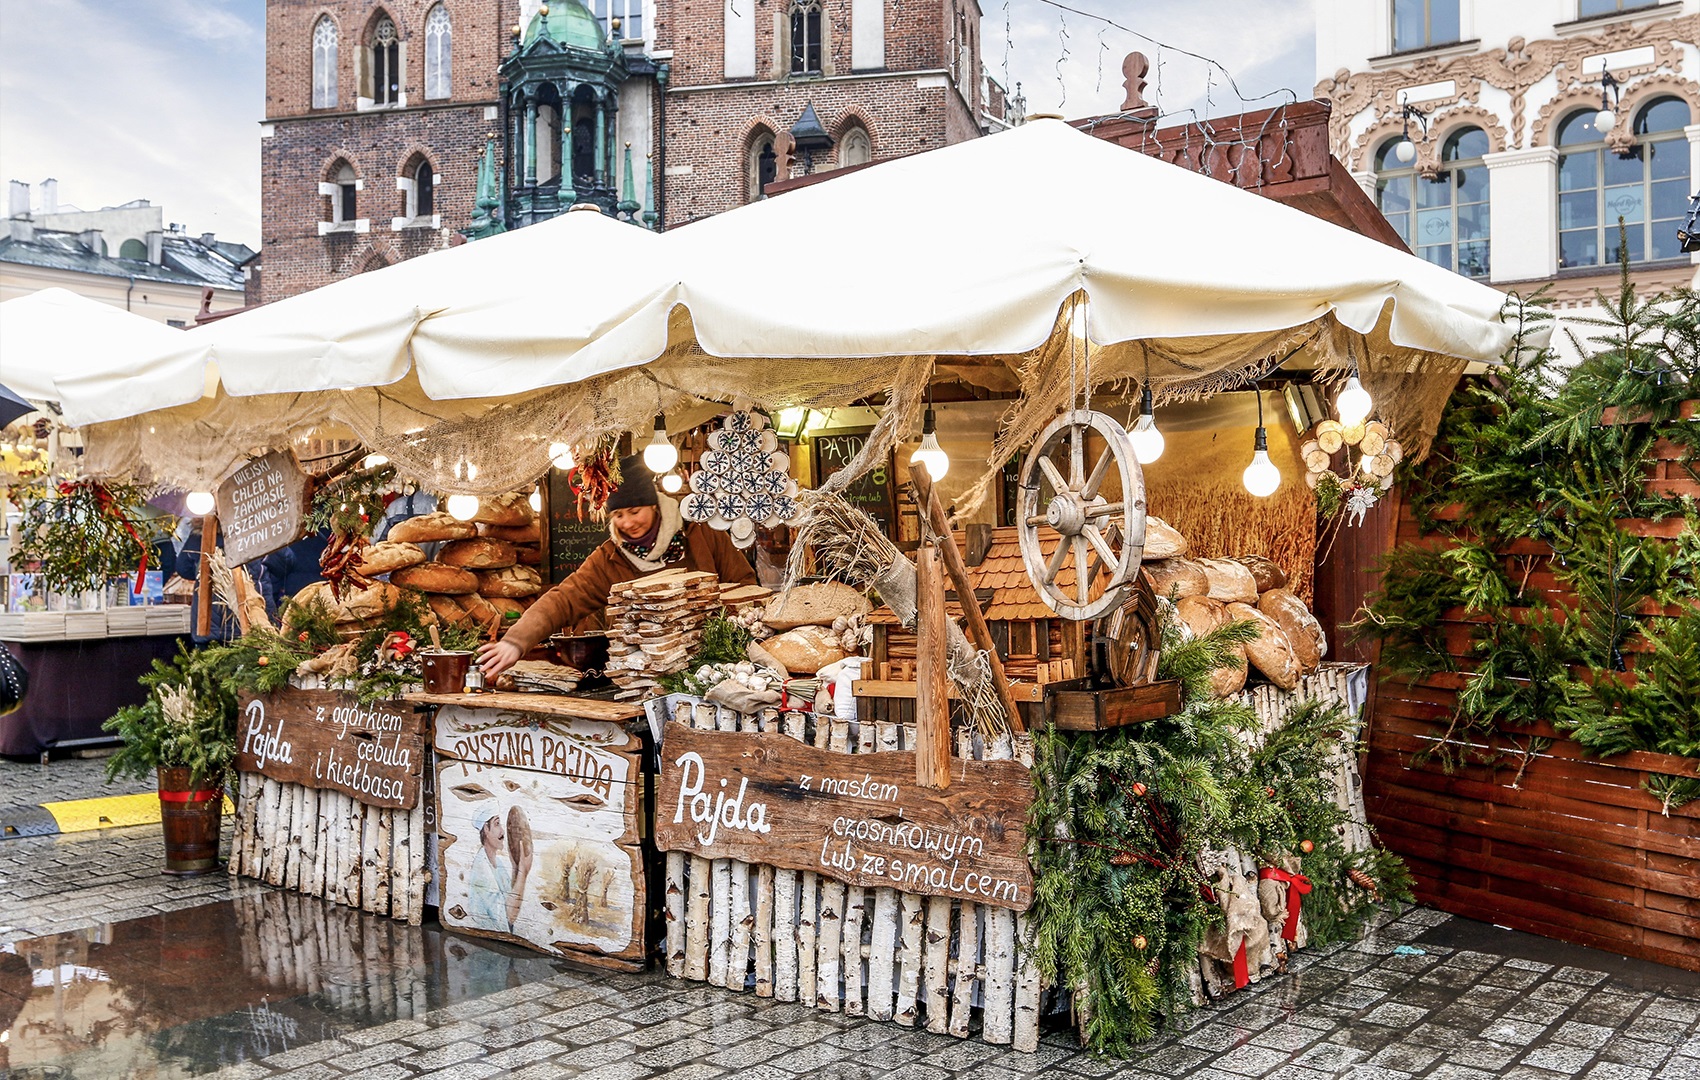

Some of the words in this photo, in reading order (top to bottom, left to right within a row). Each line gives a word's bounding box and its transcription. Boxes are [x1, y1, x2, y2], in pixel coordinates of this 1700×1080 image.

[232, 478, 266, 504] CHLEB
[267, 470, 283, 487] NA
[233, 458, 271, 486] WIEJSKI
[227, 505, 277, 539] PSZENNO
[233, 483, 287, 520] ZAKWASIE
[242, 699, 293, 769] Pajda
[316, 705, 325, 723] z
[332, 699, 403, 741] ogórkiem
[357, 731, 412, 773] cebulą
[454, 731, 536, 778] PYSZNA
[540, 735, 613, 801] PAJDA
[316, 751, 323, 779] i
[326, 747, 405, 805] kiełbasą
[799, 774, 813, 791] z
[819, 773, 899, 802] masłem
[672, 751, 771, 846] Pajda
[832, 807, 983, 860] czosnkowym
[820, 834, 856, 872] lub
[861, 853, 885, 876] ze
[889, 859, 1019, 901] smalcem
